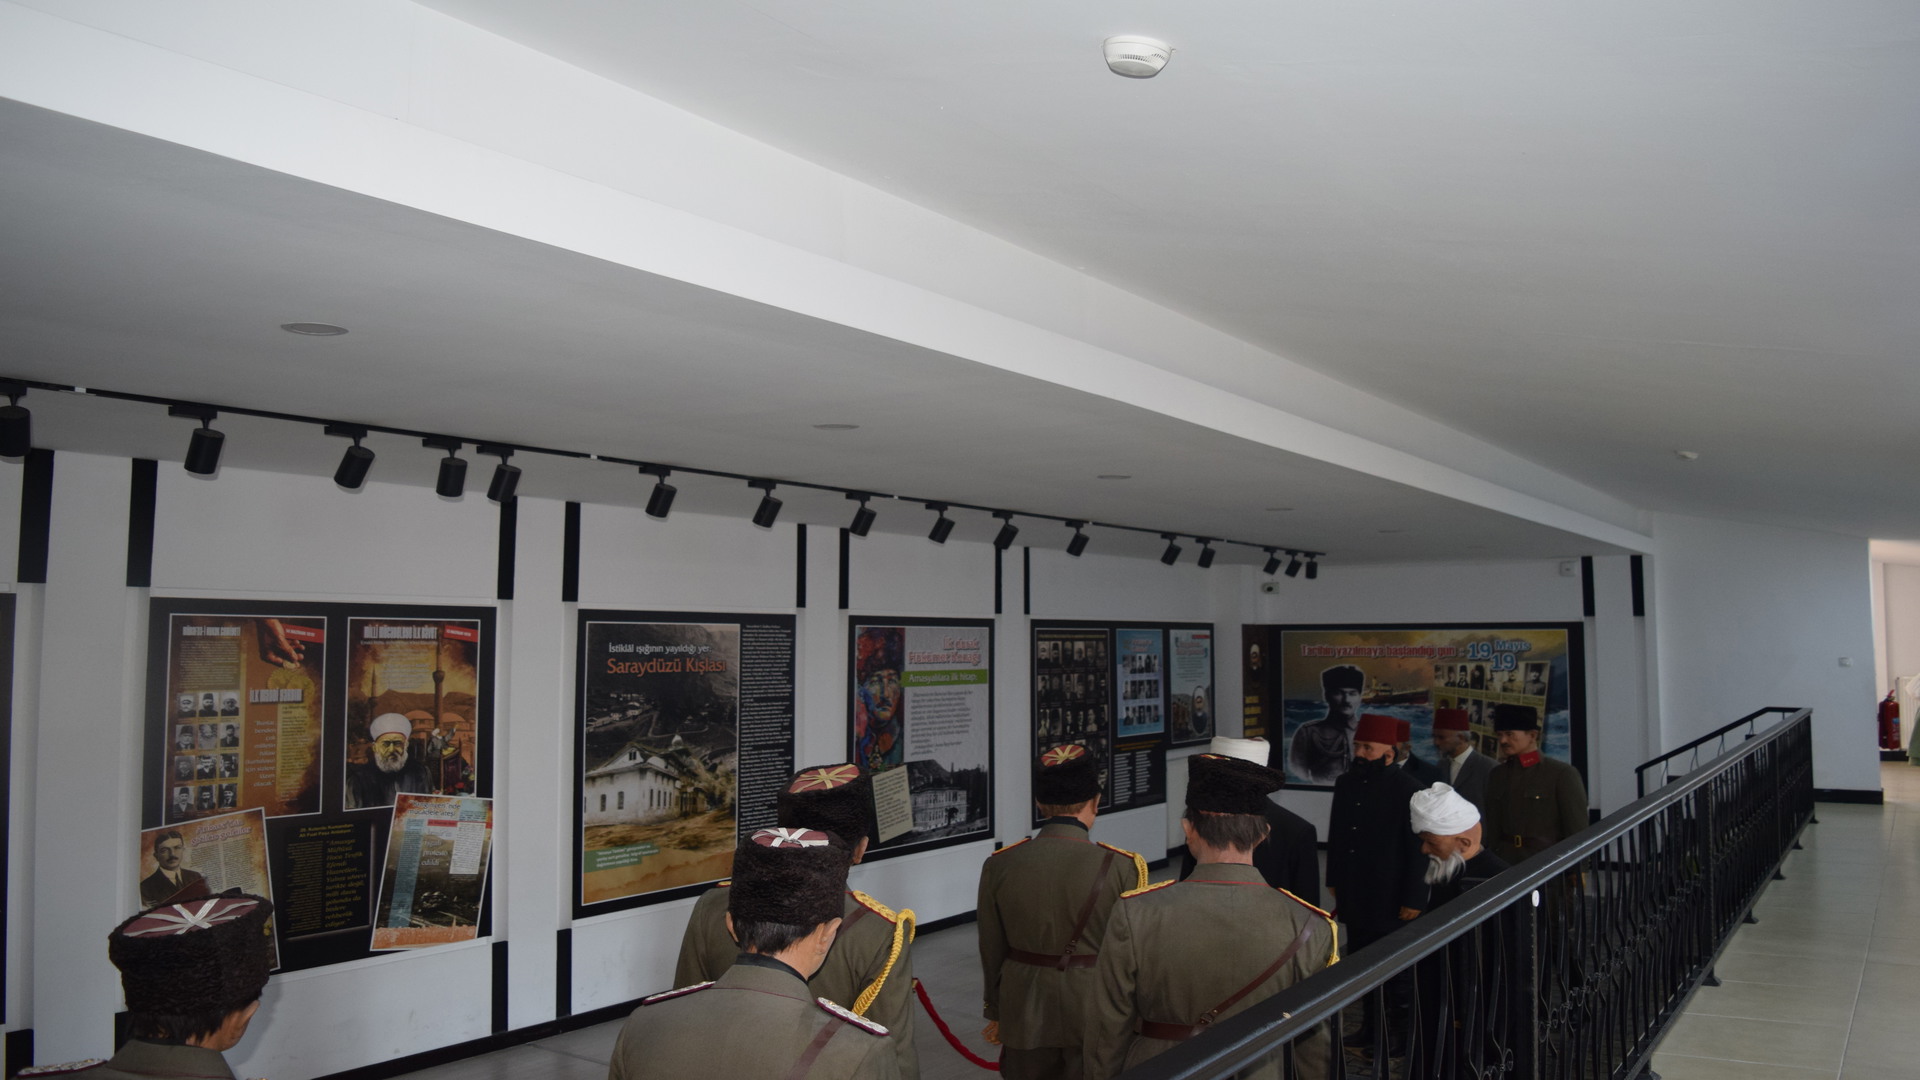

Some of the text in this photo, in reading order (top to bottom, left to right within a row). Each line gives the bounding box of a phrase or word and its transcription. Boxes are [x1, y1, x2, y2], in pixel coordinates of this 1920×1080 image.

[636, 644, 664, 655] ışığının
[665, 644, 696, 655] yayıldığı
[1301, 643, 1334, 658] Tarihin
[1336, 644, 1384, 659] yazılmaya
[1385, 643, 1436, 659] başlandığı
[1437, 645, 1456, 659] gün
[1467, 641, 1491, 660] 19
[1495, 640, 1531, 654] Mayıs
[607, 657, 727, 677] Saraydüzü Kışlası
[1490, 653, 1516, 671] 19
